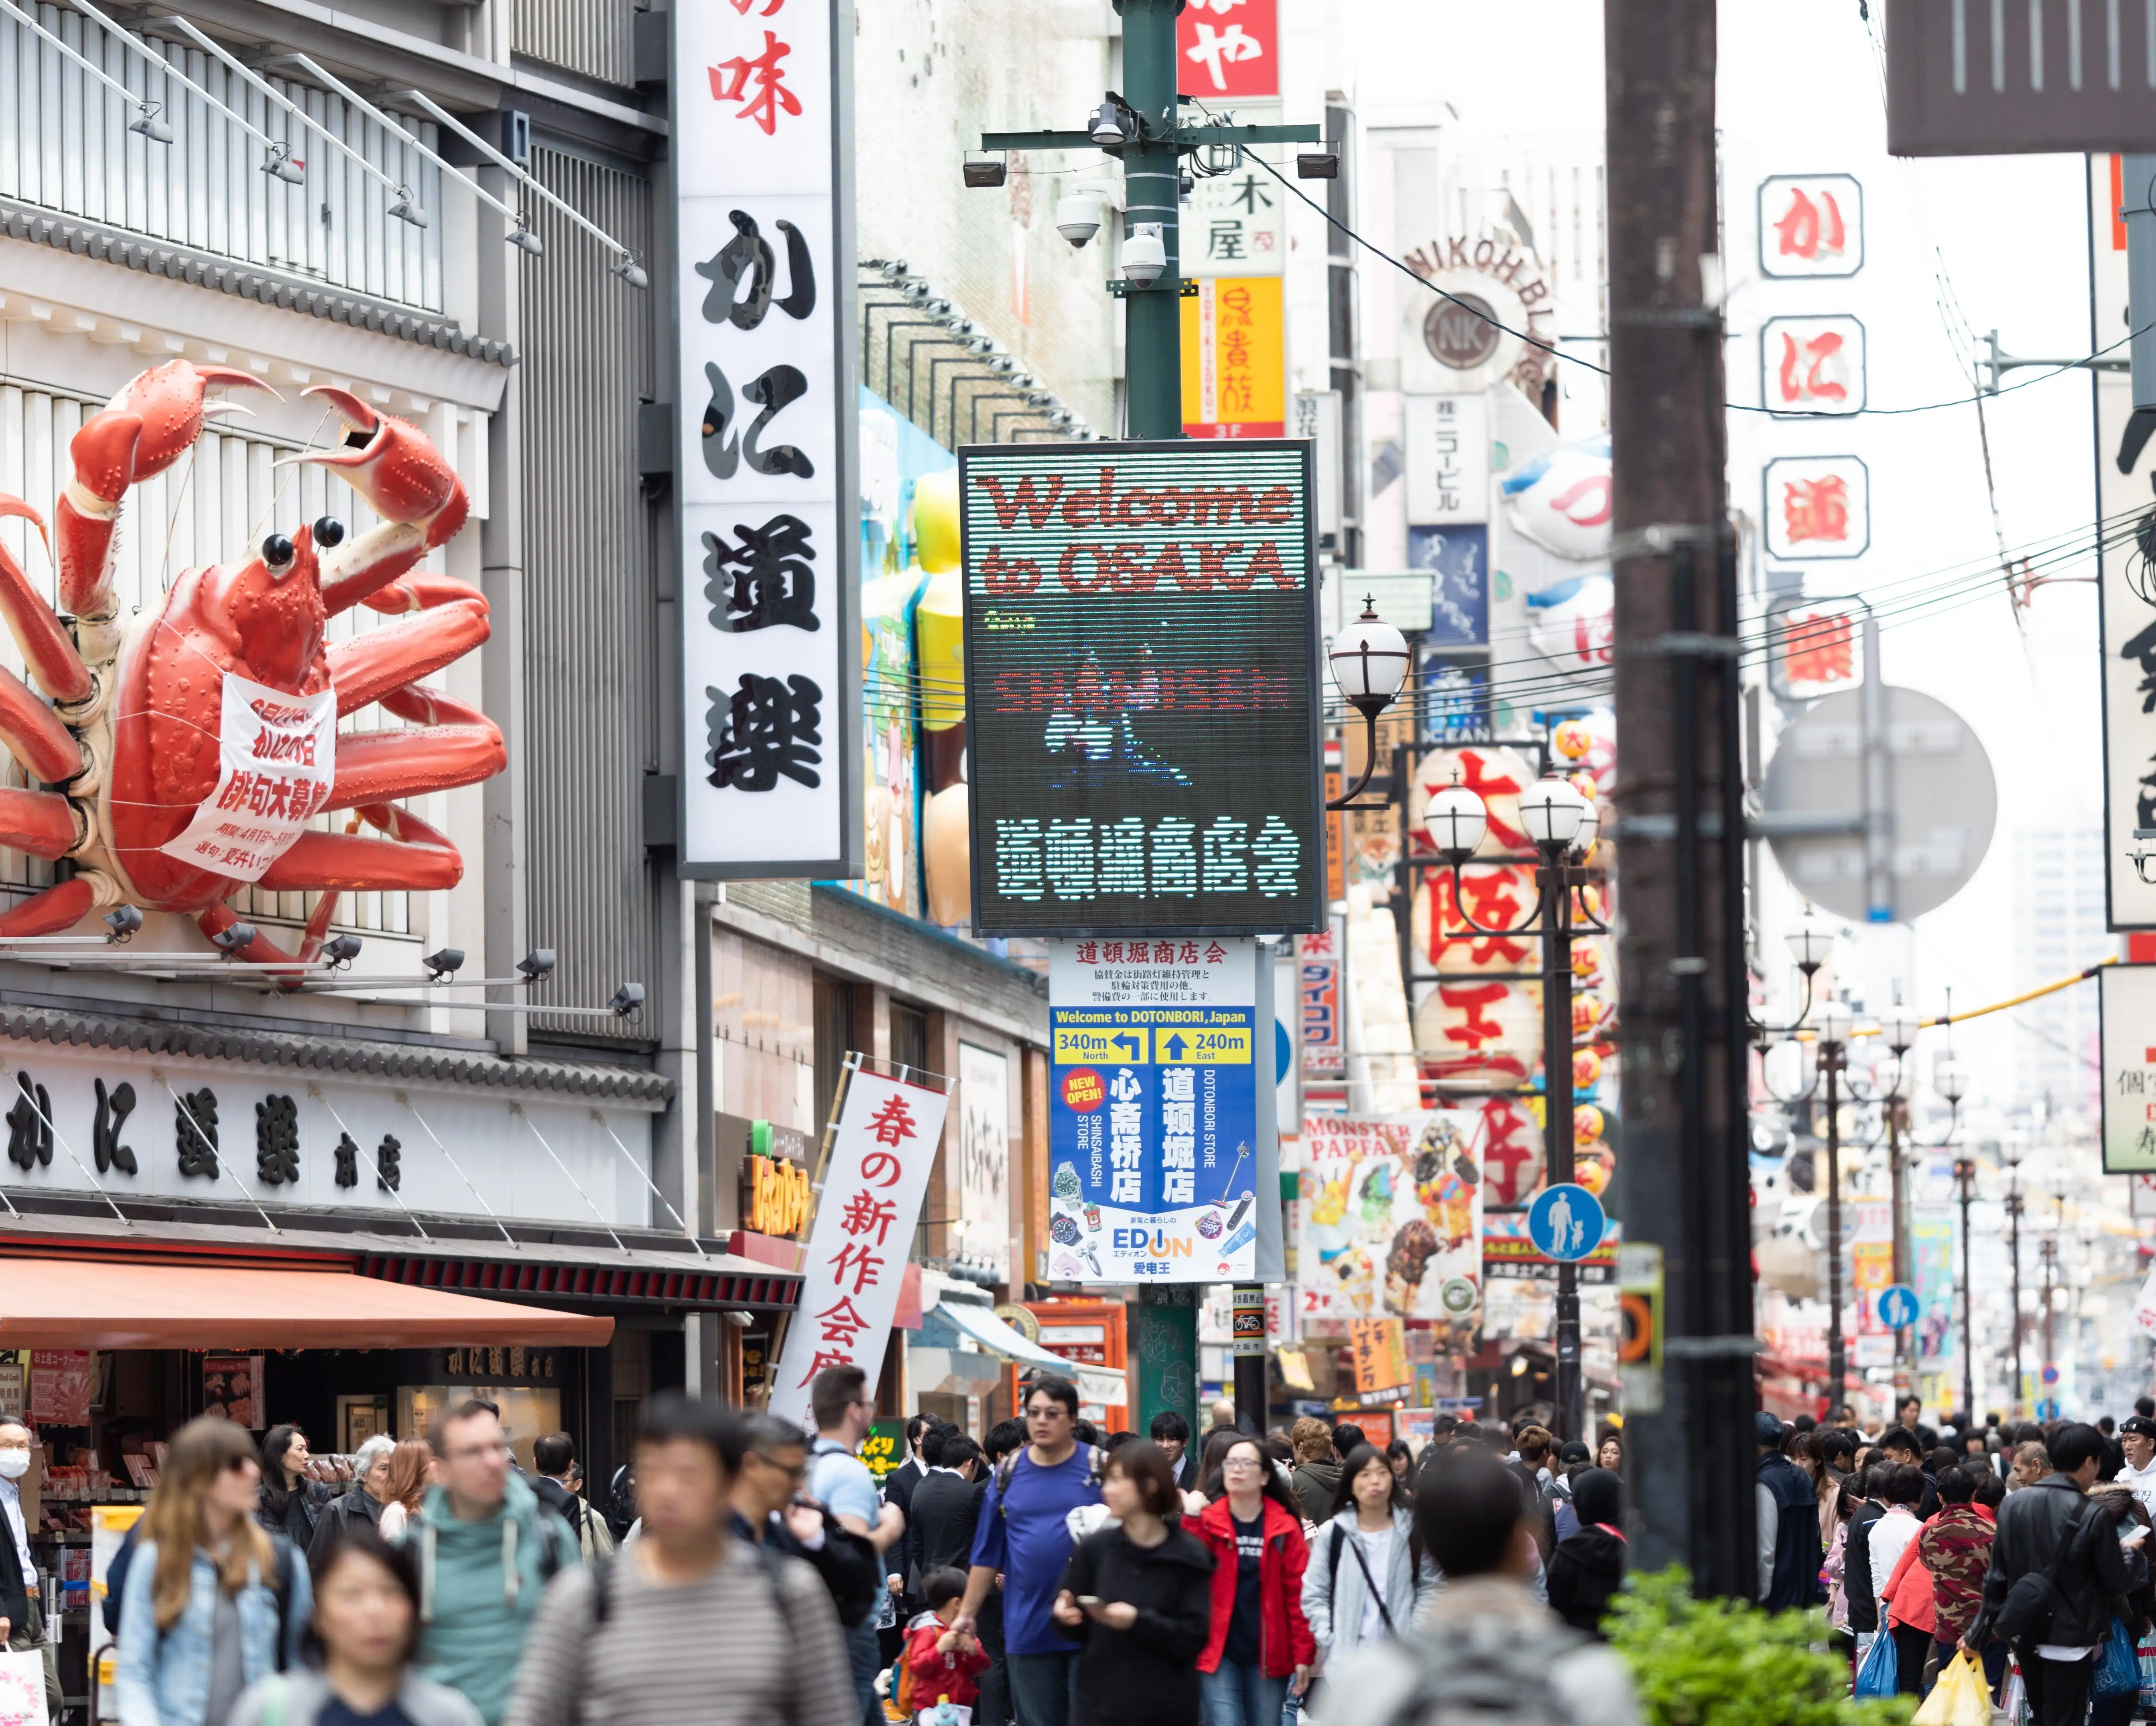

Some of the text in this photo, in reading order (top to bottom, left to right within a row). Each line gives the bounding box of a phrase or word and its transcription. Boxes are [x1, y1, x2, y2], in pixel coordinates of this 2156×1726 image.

[1186, 0, 1263, 90] や
[707, 0, 803, 136] 味
[1404, 235, 1523, 284] NIKOH
[1438, 317, 1484, 352] NK
[695, 209, 823, 792] かに道楽
[975, 468, 1294, 530] Welcome
[980, 542, 1299, 594] to OSAKA
[252, 725, 316, 766] かにの日
[216, 768, 328, 822] 俳句大募集
[1076, 940, 1228, 965] 道頓堀商店会
[1095, 969, 1210, 980] 協賛金は街路灯維持管理と
[1111, 981, 1193, 991] 駐輪対策費用の他、
[1092, 991, 1212, 1002] 警備費の一部に使用します。
[1056, 1011, 1112, 1023] Welcome
[1115, 1012, 1128, 1023] to
[1059, 1034, 1107, 1050] 340m
[1083, 1052, 1109, 1060] North
[1196, 1033, 1244, 1050] 240m
[1197, 1052, 1215, 1060] East
[1067, 1086, 1103, 1104] OPEN!
[1069, 1076, 1096, 1090] NEW
[1077, 1115, 1089, 1149] STORE
[1204, 1069, 1215, 1168] DOTONBORI STORE
[1304, 1118, 1411, 1139] MONSTER
[1110, 1067, 1142, 1203] 心斋桥店
[1162, 1067, 1195, 1203] 道顿堀店
[1091, 1115, 1102, 1188] SHINSAIBASHI
[1310, 1138, 1411, 1162] PARFAT
[1113, 1229, 1192, 1258] EDION
[1134, 1262, 1170, 1274] 爱电王
